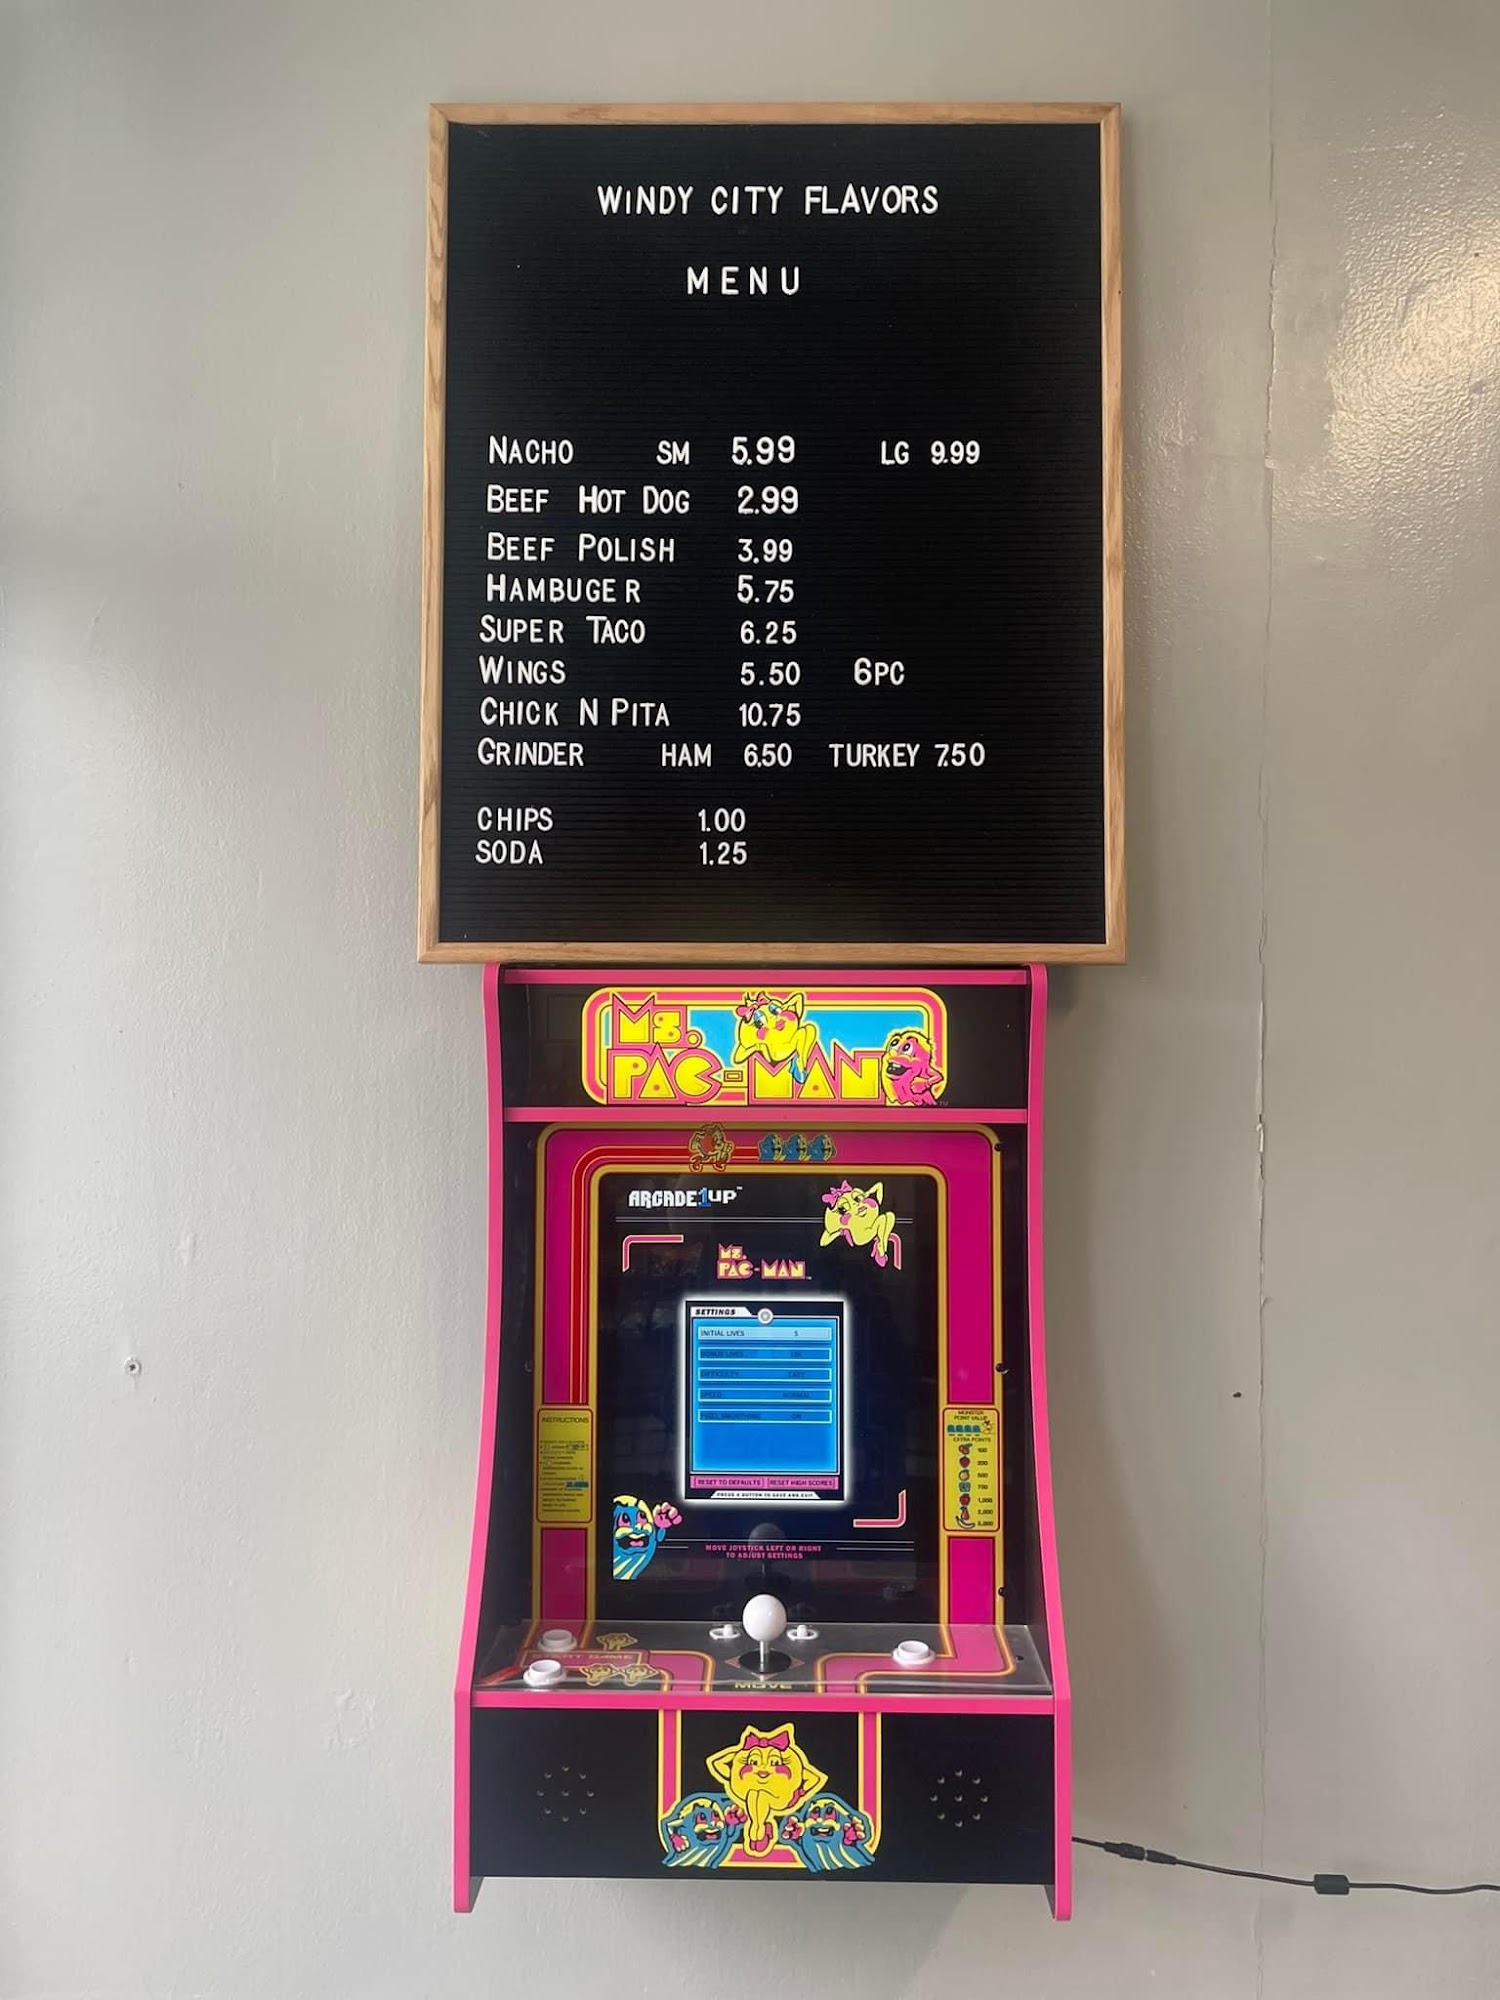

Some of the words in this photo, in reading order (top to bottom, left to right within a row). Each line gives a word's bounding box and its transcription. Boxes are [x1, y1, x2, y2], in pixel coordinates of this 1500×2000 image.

[598, 186, 693, 215] WINDY
[711, 186, 783, 214] CITY
[805, 184, 938, 214] FLAVORS
[687, 266, 800, 295] MENU
[488, 435, 574, 465] NACHO
[657, 441, 690, 464] SM
[731, 435, 795, 465] 5.99
[881, 441, 909, 465] LG
[930, 441, 981, 465] 9.99
[487, 484, 549, 513] BEEF
[579, 485, 626, 513] HOT
[642, 486, 690, 514] DOG
[737, 486, 799, 514] 2.99
[487, 532, 555, 561] BEEF
[578, 533, 675, 562] POLISH
[737, 539, 793, 563] 3.99
[737, 575, 794, 603] 5.75
[479, 615, 564, 643] SUPER
[586, 616, 646, 643] TACO
[740, 621, 797, 644] 6.25
[478, 656, 566, 684] WINGS
[740, 662, 801, 685] 5.50
[854, 658, 905, 685] 6PC
[480, 697, 558, 727] CHICK
[580, 698, 599, 726] N
[611, 698, 670, 726] PITA
[738, 703, 801, 727] 10.75
[477, 737, 584, 766] GRINDER
[661, 744, 712, 767] HAM
[743, 743, 793, 767] 6.50
[829, 743, 920, 767] TURKEY
[934, 742, 986, 767] 7.50
[477, 807, 554, 831] CHIPS
[699, 808, 746, 832] 1.00
[476, 840, 543, 864] SODA
[700, 842, 747, 865] 1.25
[606, 1043, 886, 1105] PAC-MAN
[717, 1259, 806, 1280] PAC-MAN
[705, 1544, 727, 1552] MOVE
[728, 1544, 764, 1552] JOYSTICK
[765, 1544, 785, 1552] LEFT
[786, 1544, 797, 1552] OR
[798, 1544, 822, 1552] RIGHT
[726, 1551, 736, 1559] TO
[737, 1551, 766, 1559] ADJUST
[767, 1552, 804, 1560] SETTINGS
[735, 1681, 792, 1689] MOVE
